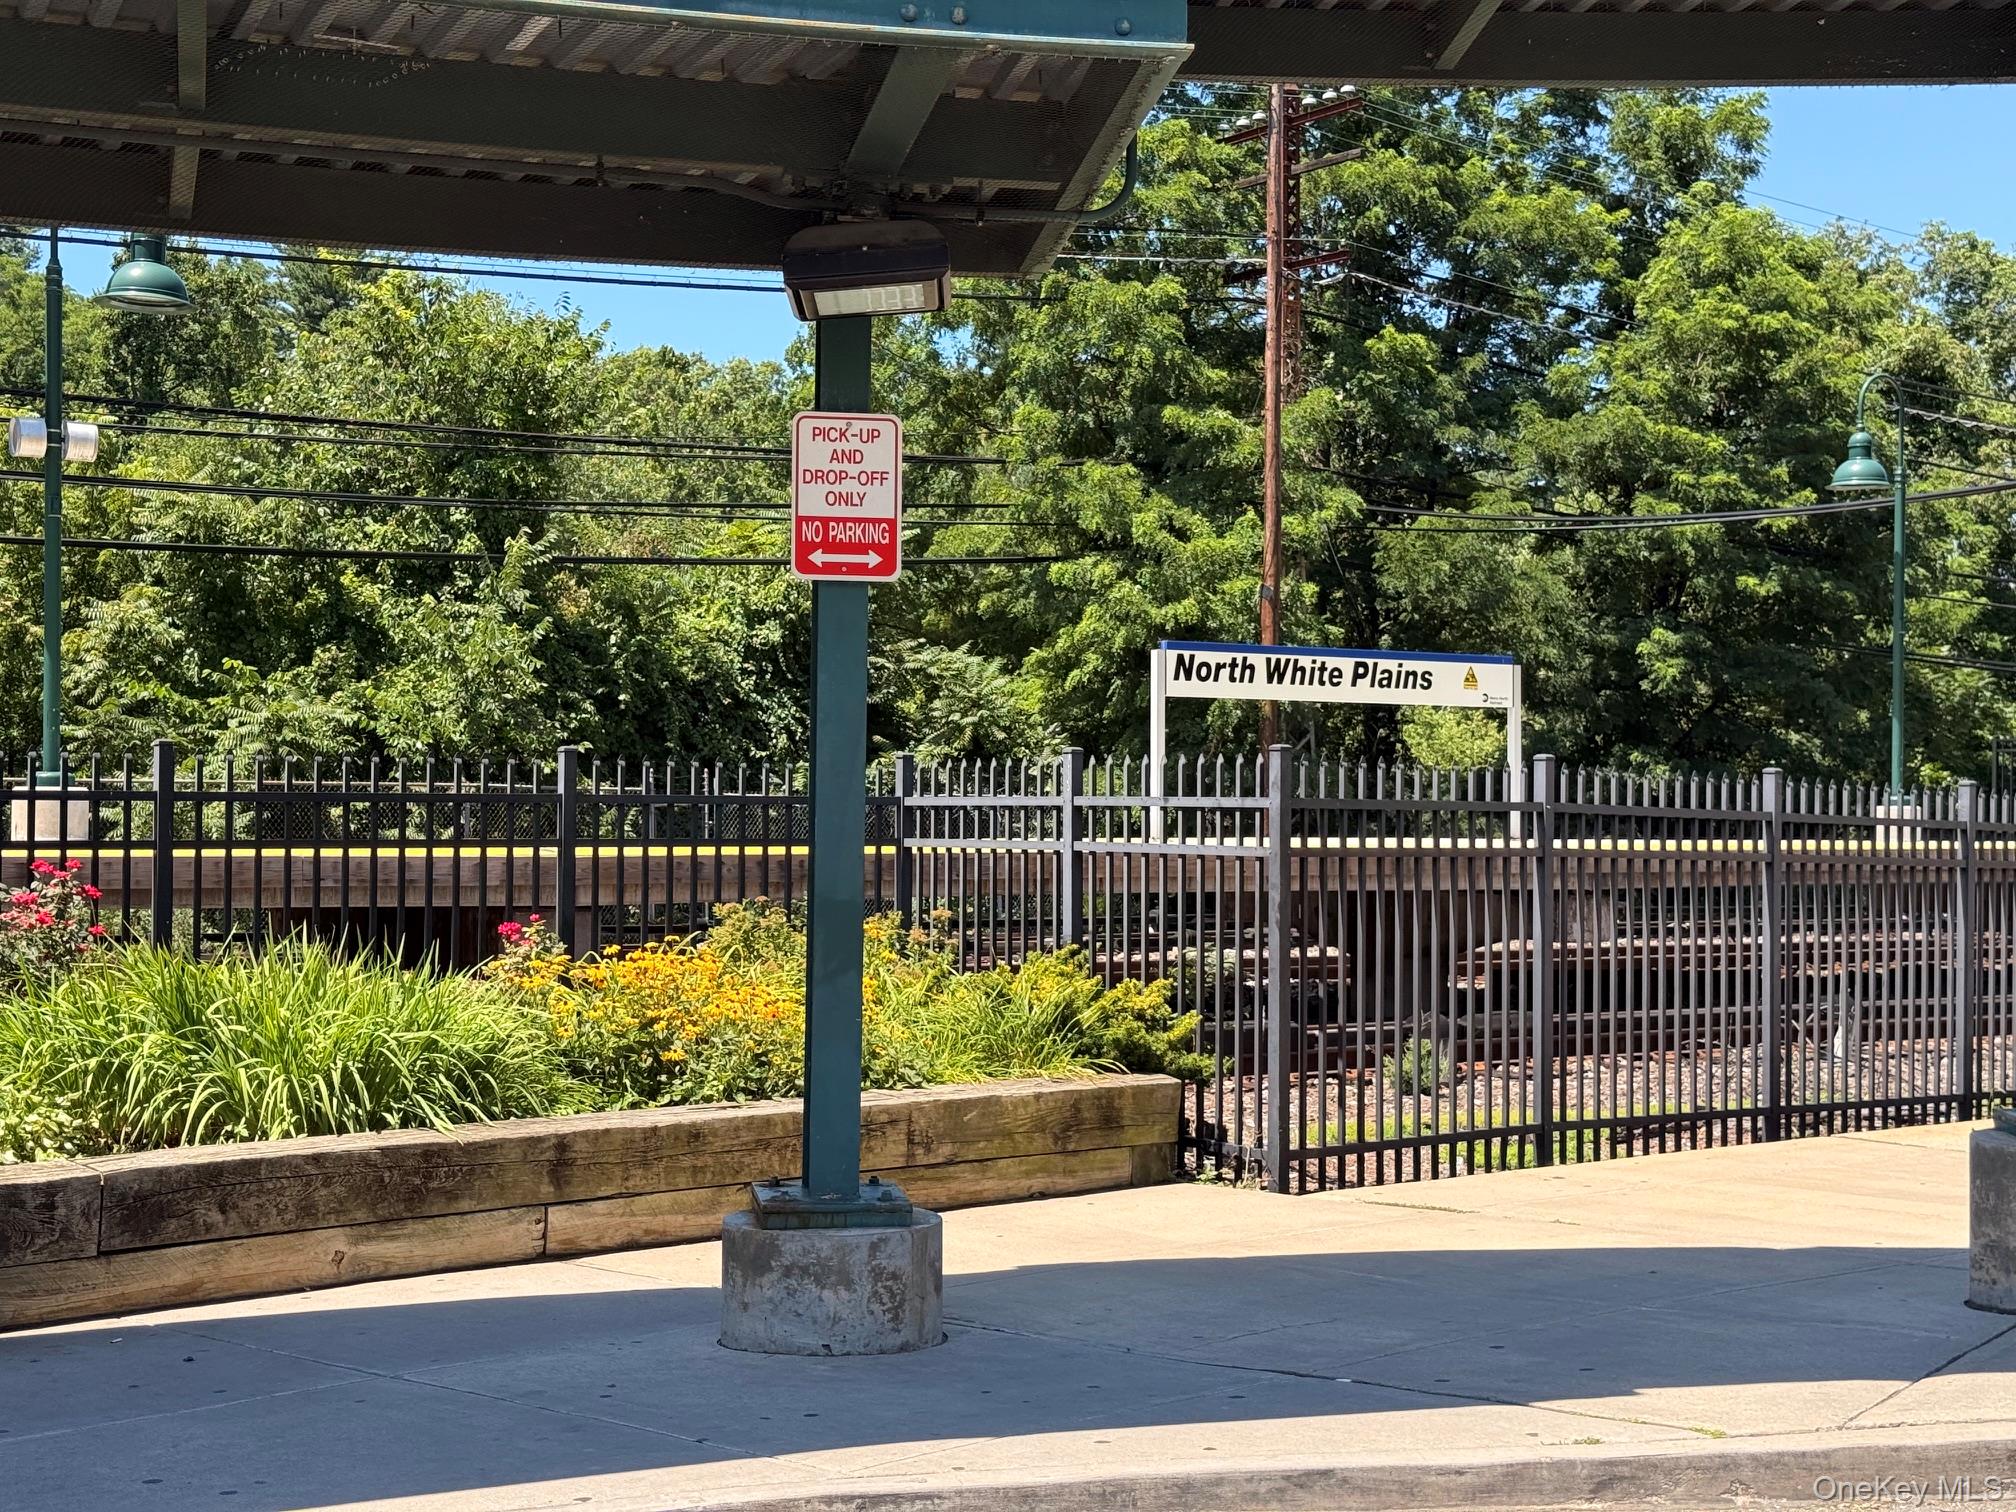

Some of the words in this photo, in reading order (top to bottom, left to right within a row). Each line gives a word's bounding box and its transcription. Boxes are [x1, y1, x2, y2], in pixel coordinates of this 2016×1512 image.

[812, 426, 881, 444] PICK-UP
[829, 449, 864, 465] AND
[802, 469, 890, 487] DROP-OFF
[825, 491, 867, 507] ONLY
[802, 520, 823, 543] NO
[829, 521, 890, 544] PARKING
[1173, 653, 1256, 684] North
[1265, 656, 1343, 688] White
[1350, 660, 1433, 690] Plains
